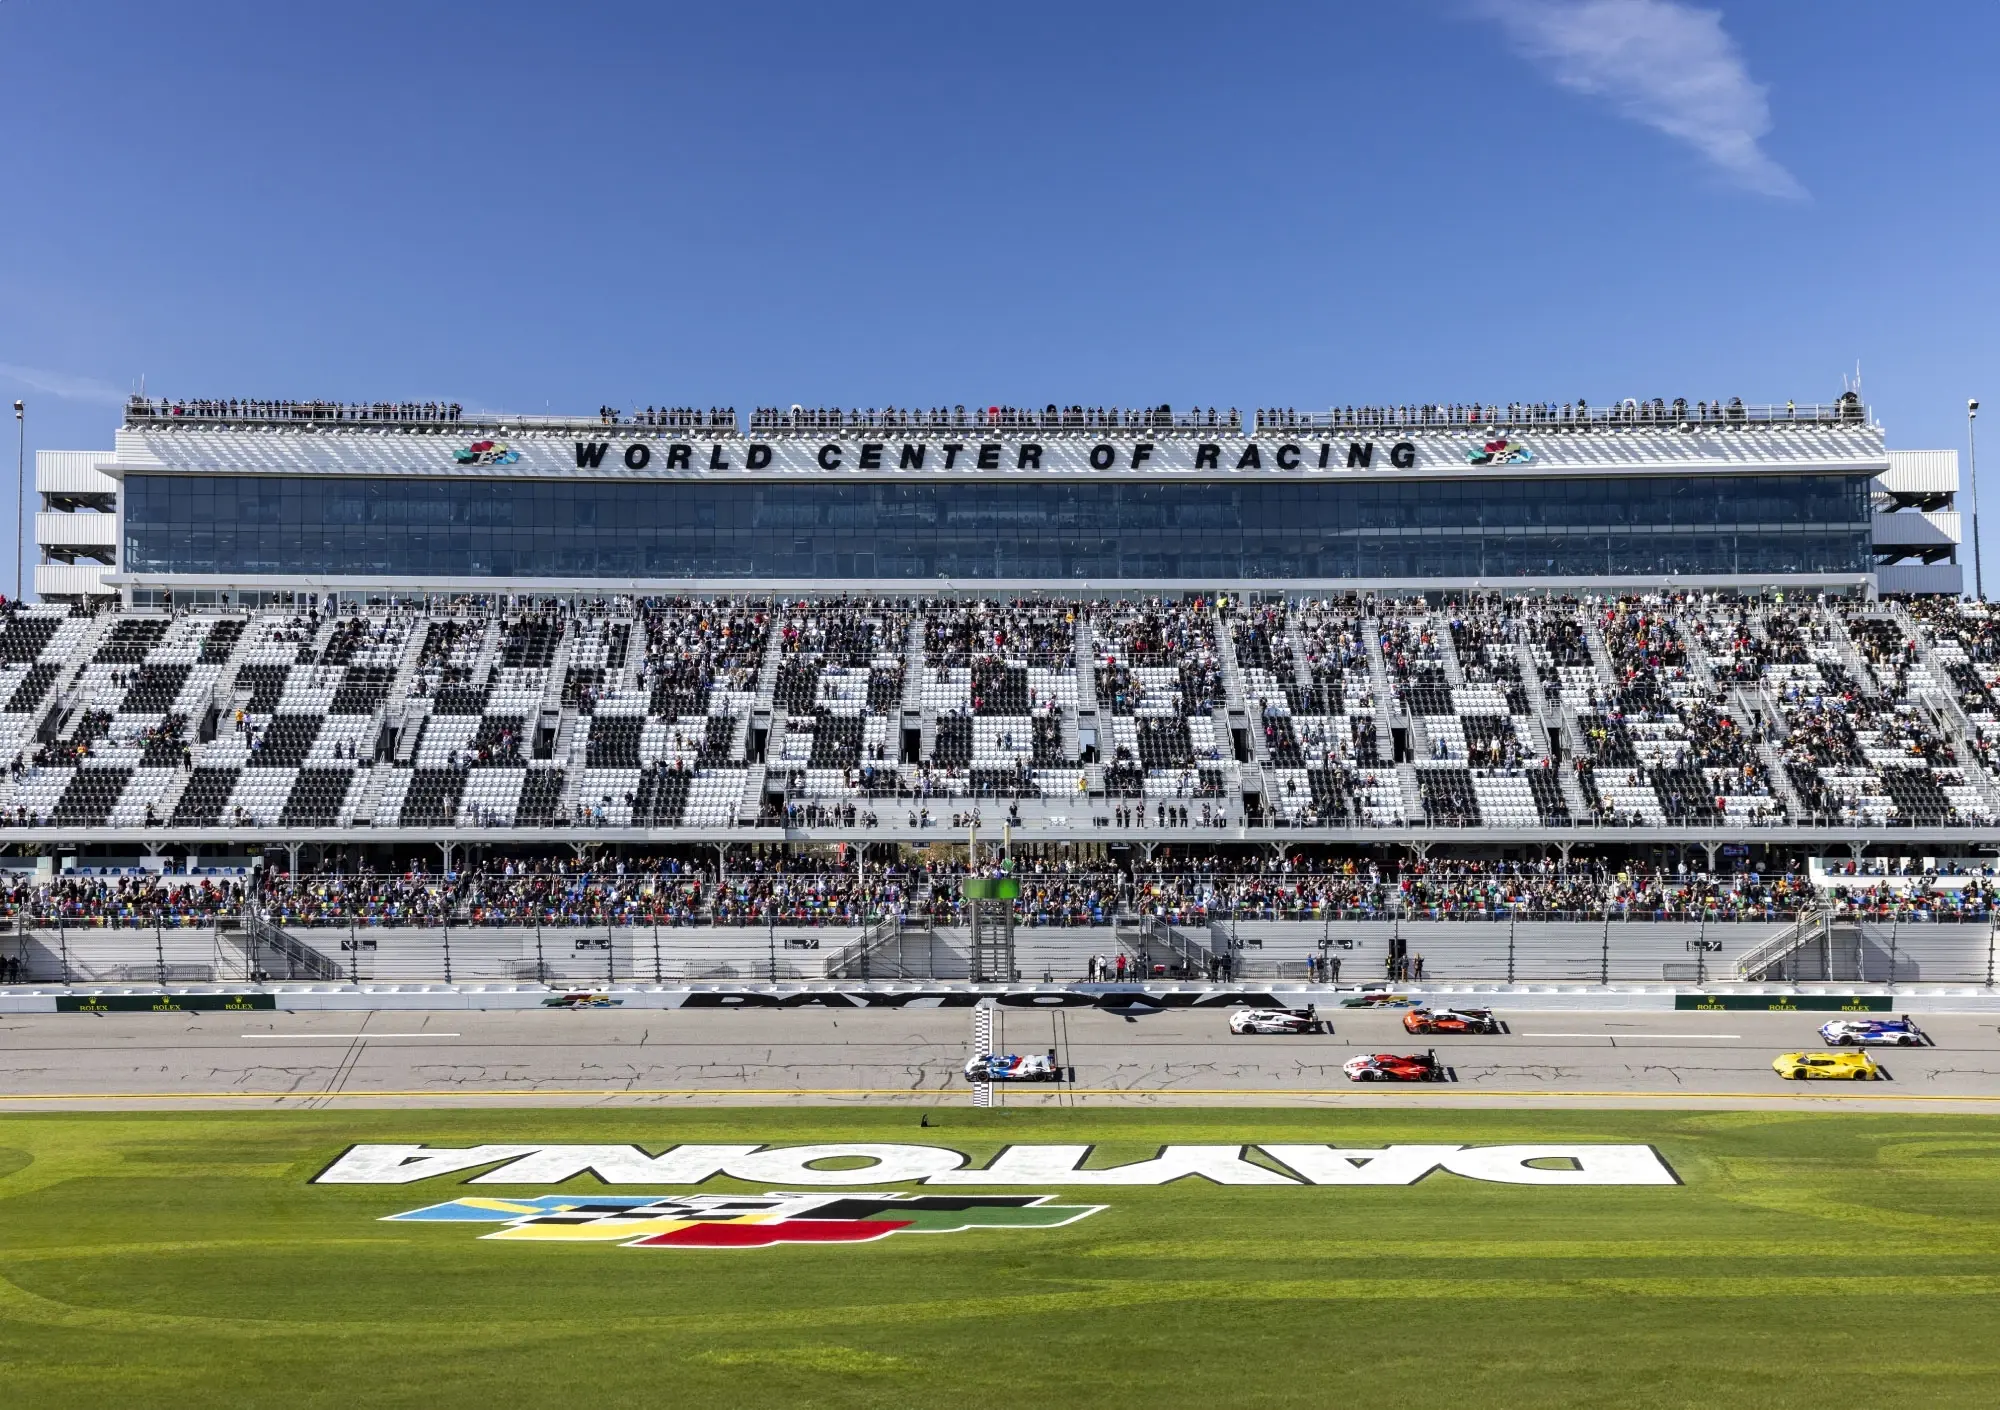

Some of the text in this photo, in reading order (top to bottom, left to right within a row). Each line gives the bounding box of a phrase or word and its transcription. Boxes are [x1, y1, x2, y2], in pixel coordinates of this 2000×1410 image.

[576, 443, 1415, 470] WORLD CENTER OF RACING
[680, 992, 1287, 1008] DAYTONA
[307, 1143, 1685, 1186] DAYTONA
